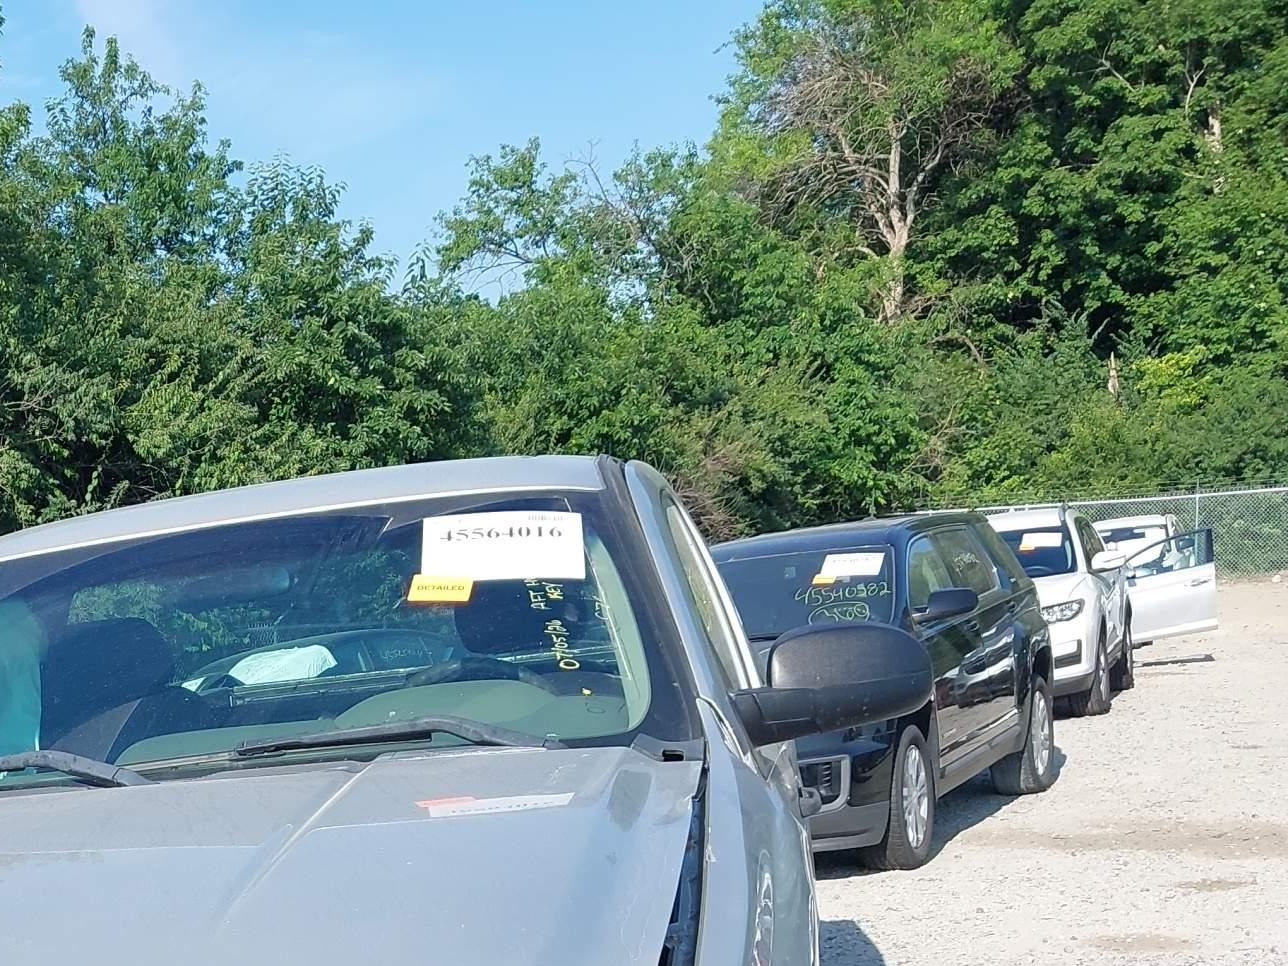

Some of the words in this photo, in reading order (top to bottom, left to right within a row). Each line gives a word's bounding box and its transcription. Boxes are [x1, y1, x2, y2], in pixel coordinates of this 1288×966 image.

[439, 526, 563, 542] 45564016
[416, 584, 466, 593] DETAILED
[541, 581, 564, 600] KEY
